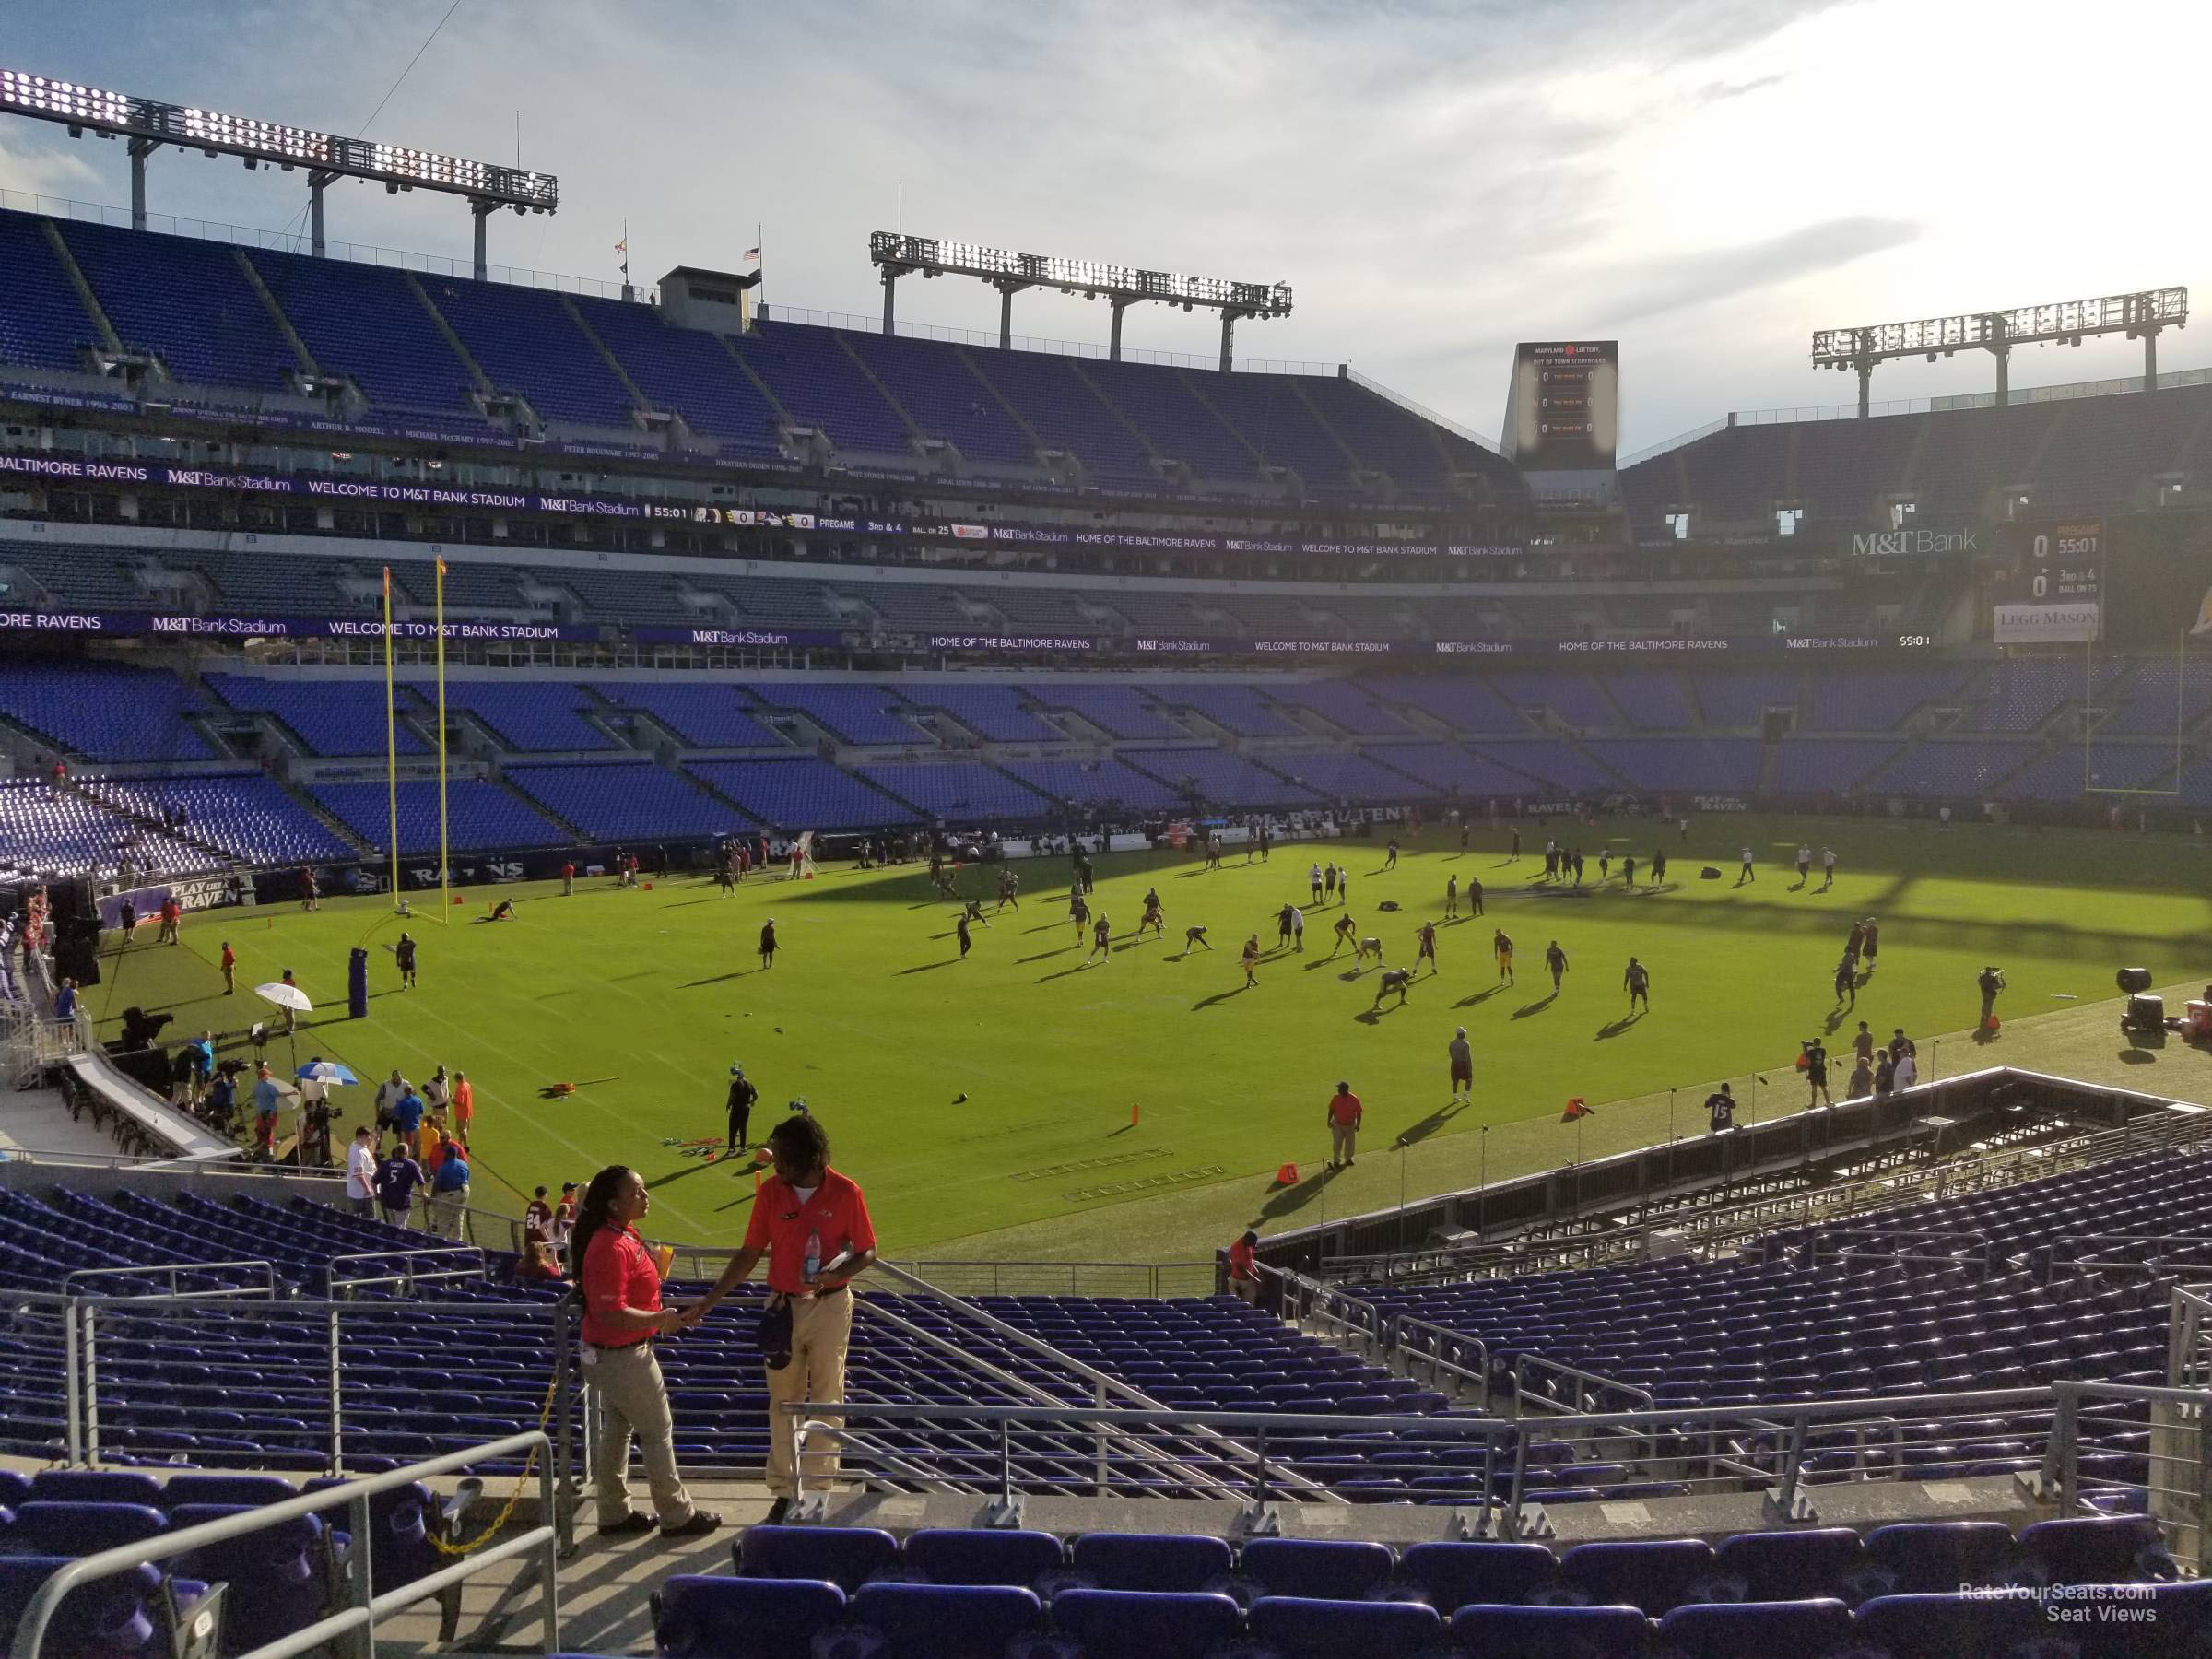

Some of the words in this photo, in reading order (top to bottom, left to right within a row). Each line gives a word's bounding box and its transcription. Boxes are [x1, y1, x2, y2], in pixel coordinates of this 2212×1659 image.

[1543, 372, 1548, 382] 0
[1543, 398, 1548, 407] 0
[311, 421, 343, 431] ARTHUR
[354, 427, 384, 436] MODELL
[1541, 424, 1547, 433] 0
[406, 429, 438, 441] MICHAEL
[563, 445, 584, 453] PETER
[586, 447, 622, 457] BOULWARE
[86, 465, 147, 480] RAVENS
[167, 469, 204, 485] M&T
[204, 472, 236, 488] Bank
[237, 474, 290, 491] Stadium
[308, 481, 377, 497] WELCOME
[381, 487, 399, 498] TO
[404, 488, 429, 500] M&T
[434, 491, 467, 503] BANK
[472, 494, 524, 507] STADIUM
[540, 498, 570, 511] M&T
[570, 500, 595, 512] Bank
[596, 501, 639, 516] Stadium
[654, 507, 687, 518] 55:01
[740, 512, 747, 523] 0
[800, 517, 808, 527] 0
[820, 518, 855, 529] PREGAME
[896, 524, 901, 532] 4
[938, 526, 949, 535] 25
[994, 529, 1015, 539] M&T
[1015, 529, 1034, 540] Bank
[1035, 531, 1067, 542] Stadium
[1077, 534, 1101, 544] HOME
[1104, 535, 1115, 544] OF
[1118, 536, 1134, 546] THE
[1135, 536, 1182, 547] BALTIMORE
[1184, 538, 1215, 548] RAVENS
[1851, 530, 1913, 555] M&T
[1917, 527, 1977, 553] Bank
[1226, 540, 1244, 549] M&T
[1244, 542, 1263, 550] Bank
[1264, 542, 1292, 551] Stadium
[1301, 544, 1340, 553] WELCOME
[1377, 546, 1399, 554] BANK
[1401, 546, 1437, 555] STADIUM
[1449, 546, 1467, 555] M&T
[1489, 547, 1523, 556] Stadium
[2033, 535, 2048, 558] 0
[2058, 537, 2097, 553] 55:01
[2087, 568, 2095, 581] 4
[2033, 575, 2046, 597] 0
[2059, 585, 2076, 594] BALL
[37, 614, 101, 629] RAVENS
[2002, 613, 2039, 626] LEGG
[2042, 612, 2096, 625] MASON
[152, 617, 191, 632] M&T
[192, 618, 229, 632] Bank
[229, 618, 286, 634] Stadium
[329, 623, 402, 635] WELCOME
[406, 623, 426, 635] TO
[429, 625, 459, 636] M&T
[463, 625, 498, 637] BANK
[501, 626, 559, 638] STADIUM
[692, 630, 721, 642] M&T
[721, 631, 745, 643] Bank
[747, 632, 787, 644] Stadium
[931, 637, 960, 647] HOME
[962, 638, 977, 647] OF
[979, 638, 997, 647] THE
[1000, 638, 1053, 649] BALTIMORE
[1054, 640, 1089, 649] RAVENS
[1900, 636, 1930, 646] 55:01
[1137, 640, 1158, 650] M&T
[1158, 640, 1178, 650] Bank
[1178, 640, 1209, 651] Stadium
[1255, 641, 1296, 651] WELCOME
[1299, 641, 1311, 651] TO
[1312, 642, 1329, 651] M&T
[1331, 642, 1353, 651] BANK
[1355, 642, 1388, 653] STADIUM
[1436, 642, 1456, 653] M&T
[1477, 643, 1512, 653] Stadium
[1559, 641, 1588, 651] HOME
[1591, 641, 1605, 651] OF
[1607, 641, 1626, 651] THE
[1629, 641, 1685, 651] BALTIMORE
[1688, 640, 1727, 649] RAVENS
[1786, 638, 1812, 649] M&T
[1812, 638, 1836, 648] Bank
[1838, 638, 1877, 649] Stadium
[170, 881, 206, 898] PLAY
[206, 881, 223, 891] LIKE
[180, 888, 238, 910] RAVEN
[1714, 1104, 1728, 1119] 15
[389, 1169, 398, 1183] 5
[527, 1213, 540, 1230] 24
